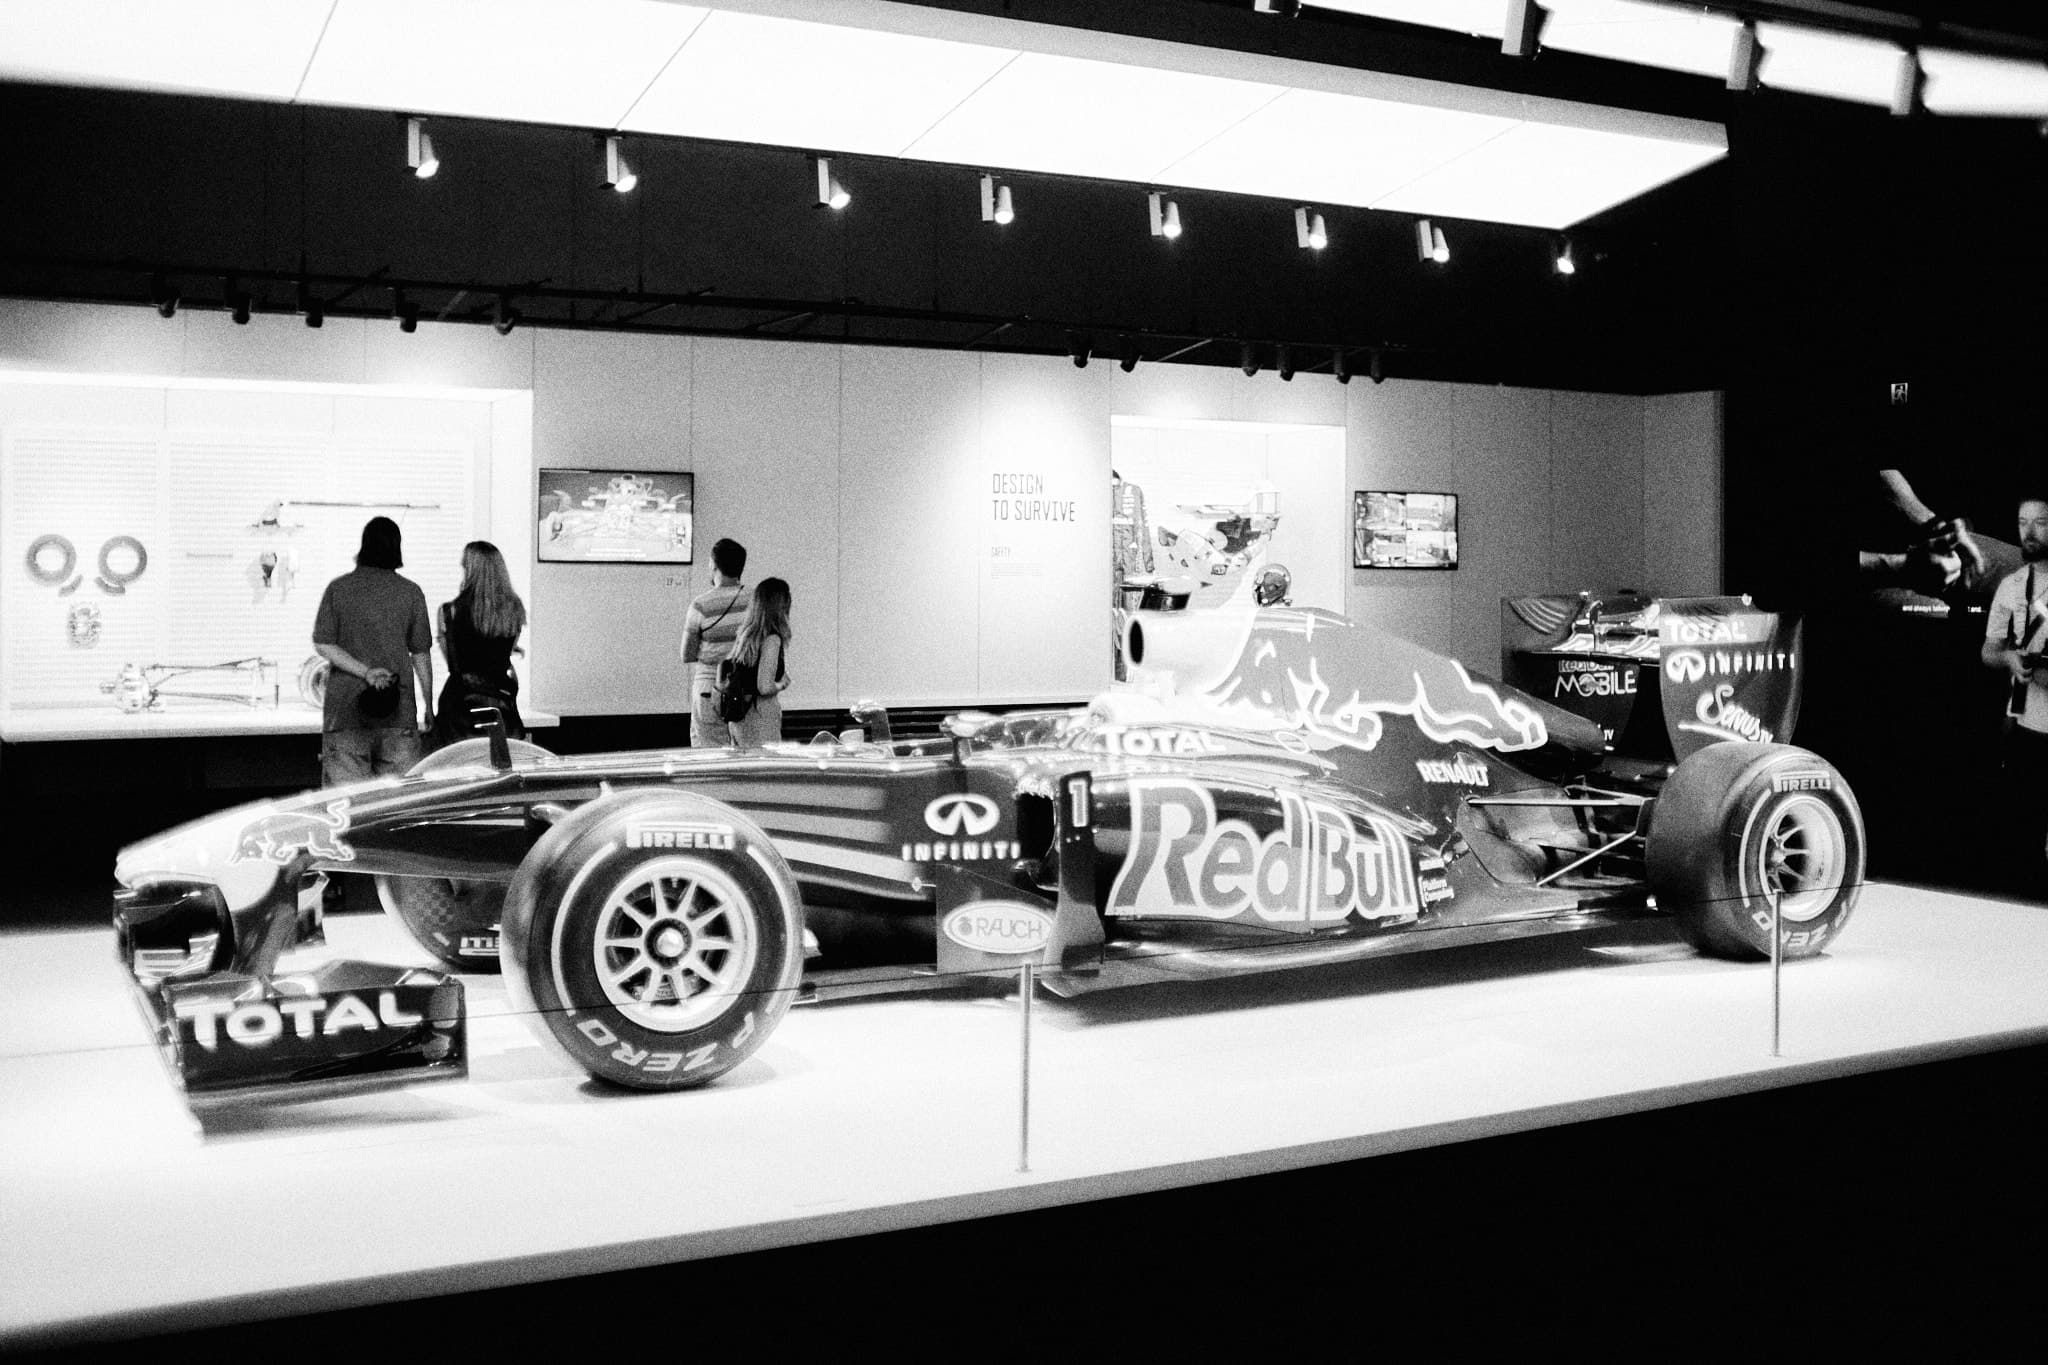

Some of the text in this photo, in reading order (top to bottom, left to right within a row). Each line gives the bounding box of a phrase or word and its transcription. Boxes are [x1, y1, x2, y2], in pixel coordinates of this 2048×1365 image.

[992, 472, 1044, 495] DESIGN
[991, 499, 1076, 522] TO SURVIVE
[1664, 619, 1748, 642] TOTAL
[1708, 650, 1796, 676] INFINITI
[1554, 669, 1638, 698] MOBILE
[1098, 725, 1227, 756] TOTAL
[1415, 760, 1490, 787] RENAULT
[1772, 769, 1832, 793] PIRELLI
[625, 822, 736, 850] PIRELLI
[901, 841, 1022, 862] INFINITI
[974, 917, 1043, 940] RAUCH
[173, 992, 423, 1051] TOTAL
[576, 1018, 719, 1073] ZERO
